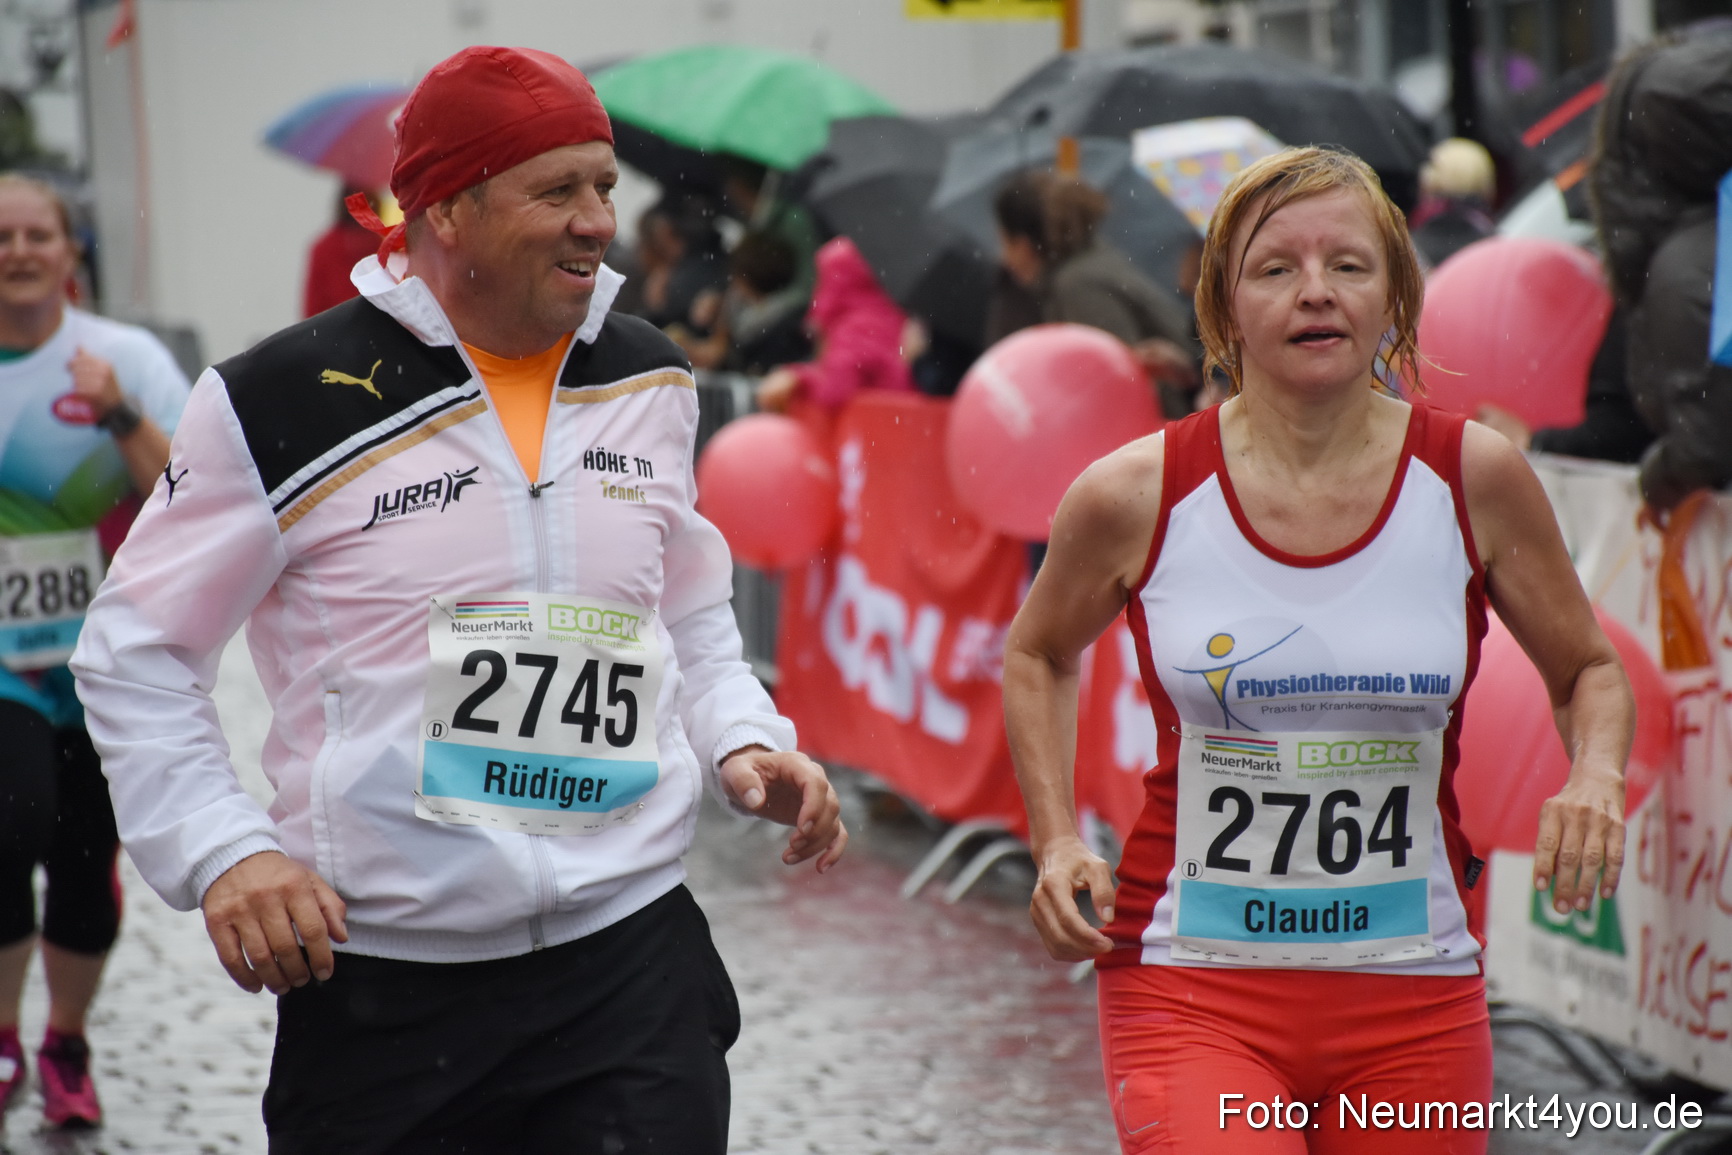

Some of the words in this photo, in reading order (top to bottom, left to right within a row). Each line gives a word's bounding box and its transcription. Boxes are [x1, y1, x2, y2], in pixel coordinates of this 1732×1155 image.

[583, 446, 630, 474] HÖHE
[600, 480, 647, 504] Tennis
[361, 478, 443, 531] JURA
[378, 510, 400, 522] SPORT
[407, 501, 438, 514] SERVICE
[451, 620, 534, 633] NeuerMarkt
[548, 603, 642, 642] BOCK
[547, 632, 582, 644] inspired
[584, 635, 595, 648] by
[1236, 672, 1406, 699] Physiotherapie
[1410, 673, 1451, 695] Wild
[451, 648, 644, 748] 2745
[1261, 703, 1297, 715] Praxis
[1301, 702, 1316, 712] für
[1320, 701, 1427, 713] Krankengymnastik
[432, 723, 443, 738] D
[1201, 752, 1282, 772] NeuerMarkt
[1297, 739, 1422, 769] BOCK
[1297, 769, 1335, 780] inspired
[1336, 768, 1348, 778] by
[1349, 768, 1376, 776] smart
[1377, 765, 1419, 775] concepts
[483, 761, 608, 809] Rüdiger
[1205, 785, 1413, 875] 2764
[1187, 862, 1197, 877] D
[1244, 899, 1369, 933] Claudia
